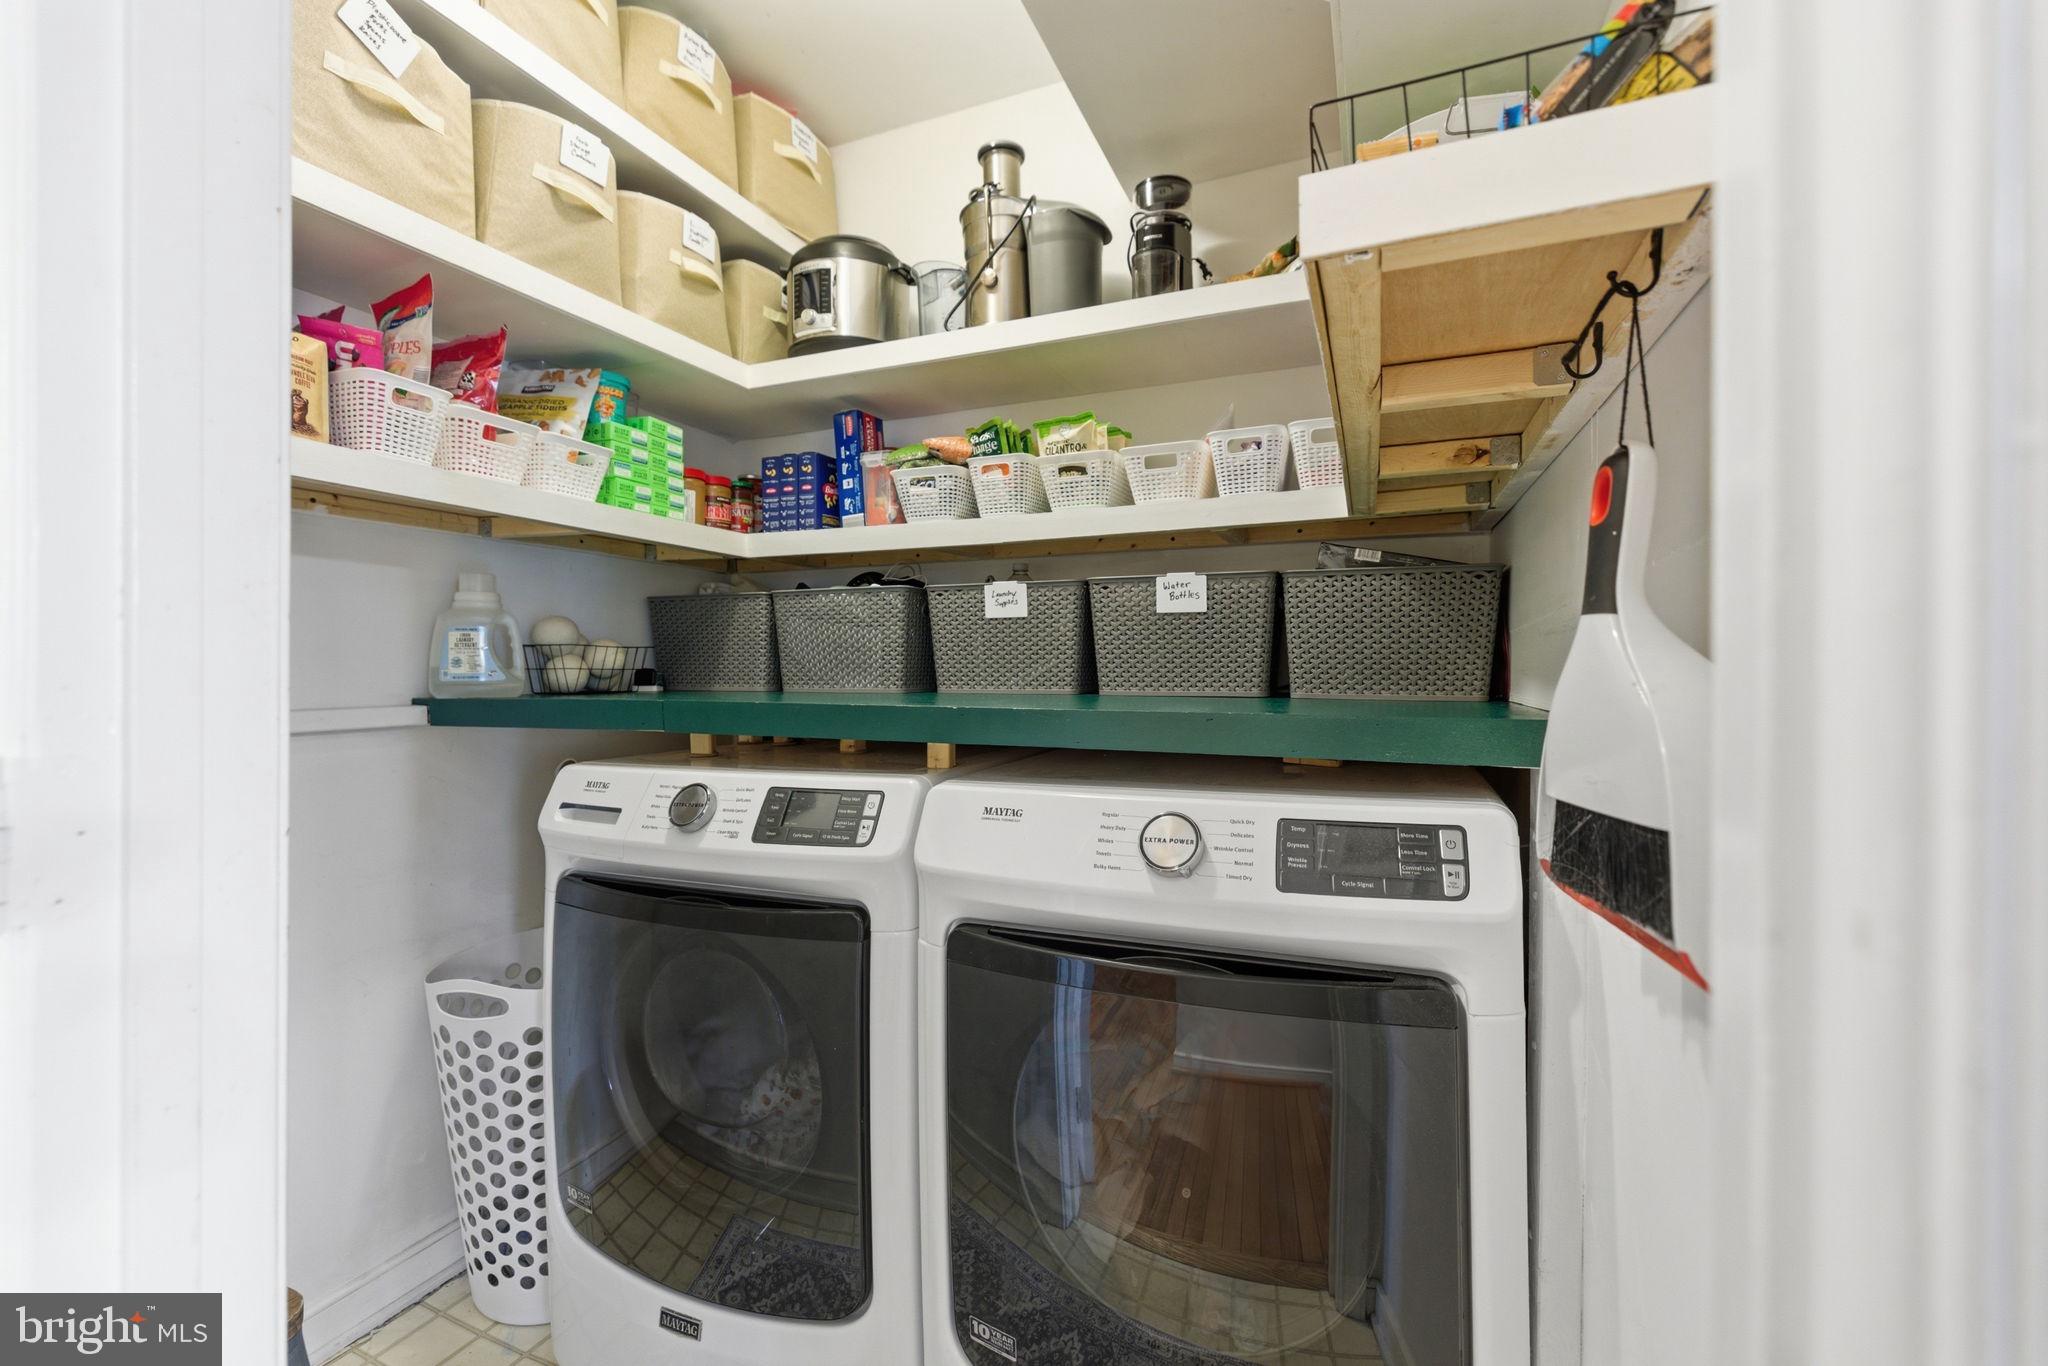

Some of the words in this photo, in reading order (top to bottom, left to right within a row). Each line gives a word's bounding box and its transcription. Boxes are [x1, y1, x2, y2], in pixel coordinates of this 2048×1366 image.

[1045, 443, 1081, 456] CILANTRO
[1163, 582, 1190, 590] Water
[1170, 591, 1200, 601] Bottles
[585, 781, 611, 789] MAYTAG
[983, 807, 1023, 817] MAYTAG
[1287, 841, 1310, 849] Dryness
[1225, 873, 1242, 881] Timed
[1341, 880, 1356, 888] Cycle
[1356, 881, 1375, 889] Signal
[568, 1186, 578, 1200] 10
[661, 1314, 698, 1336] MAYTAG
[972, 1320, 990, 1340] 10
